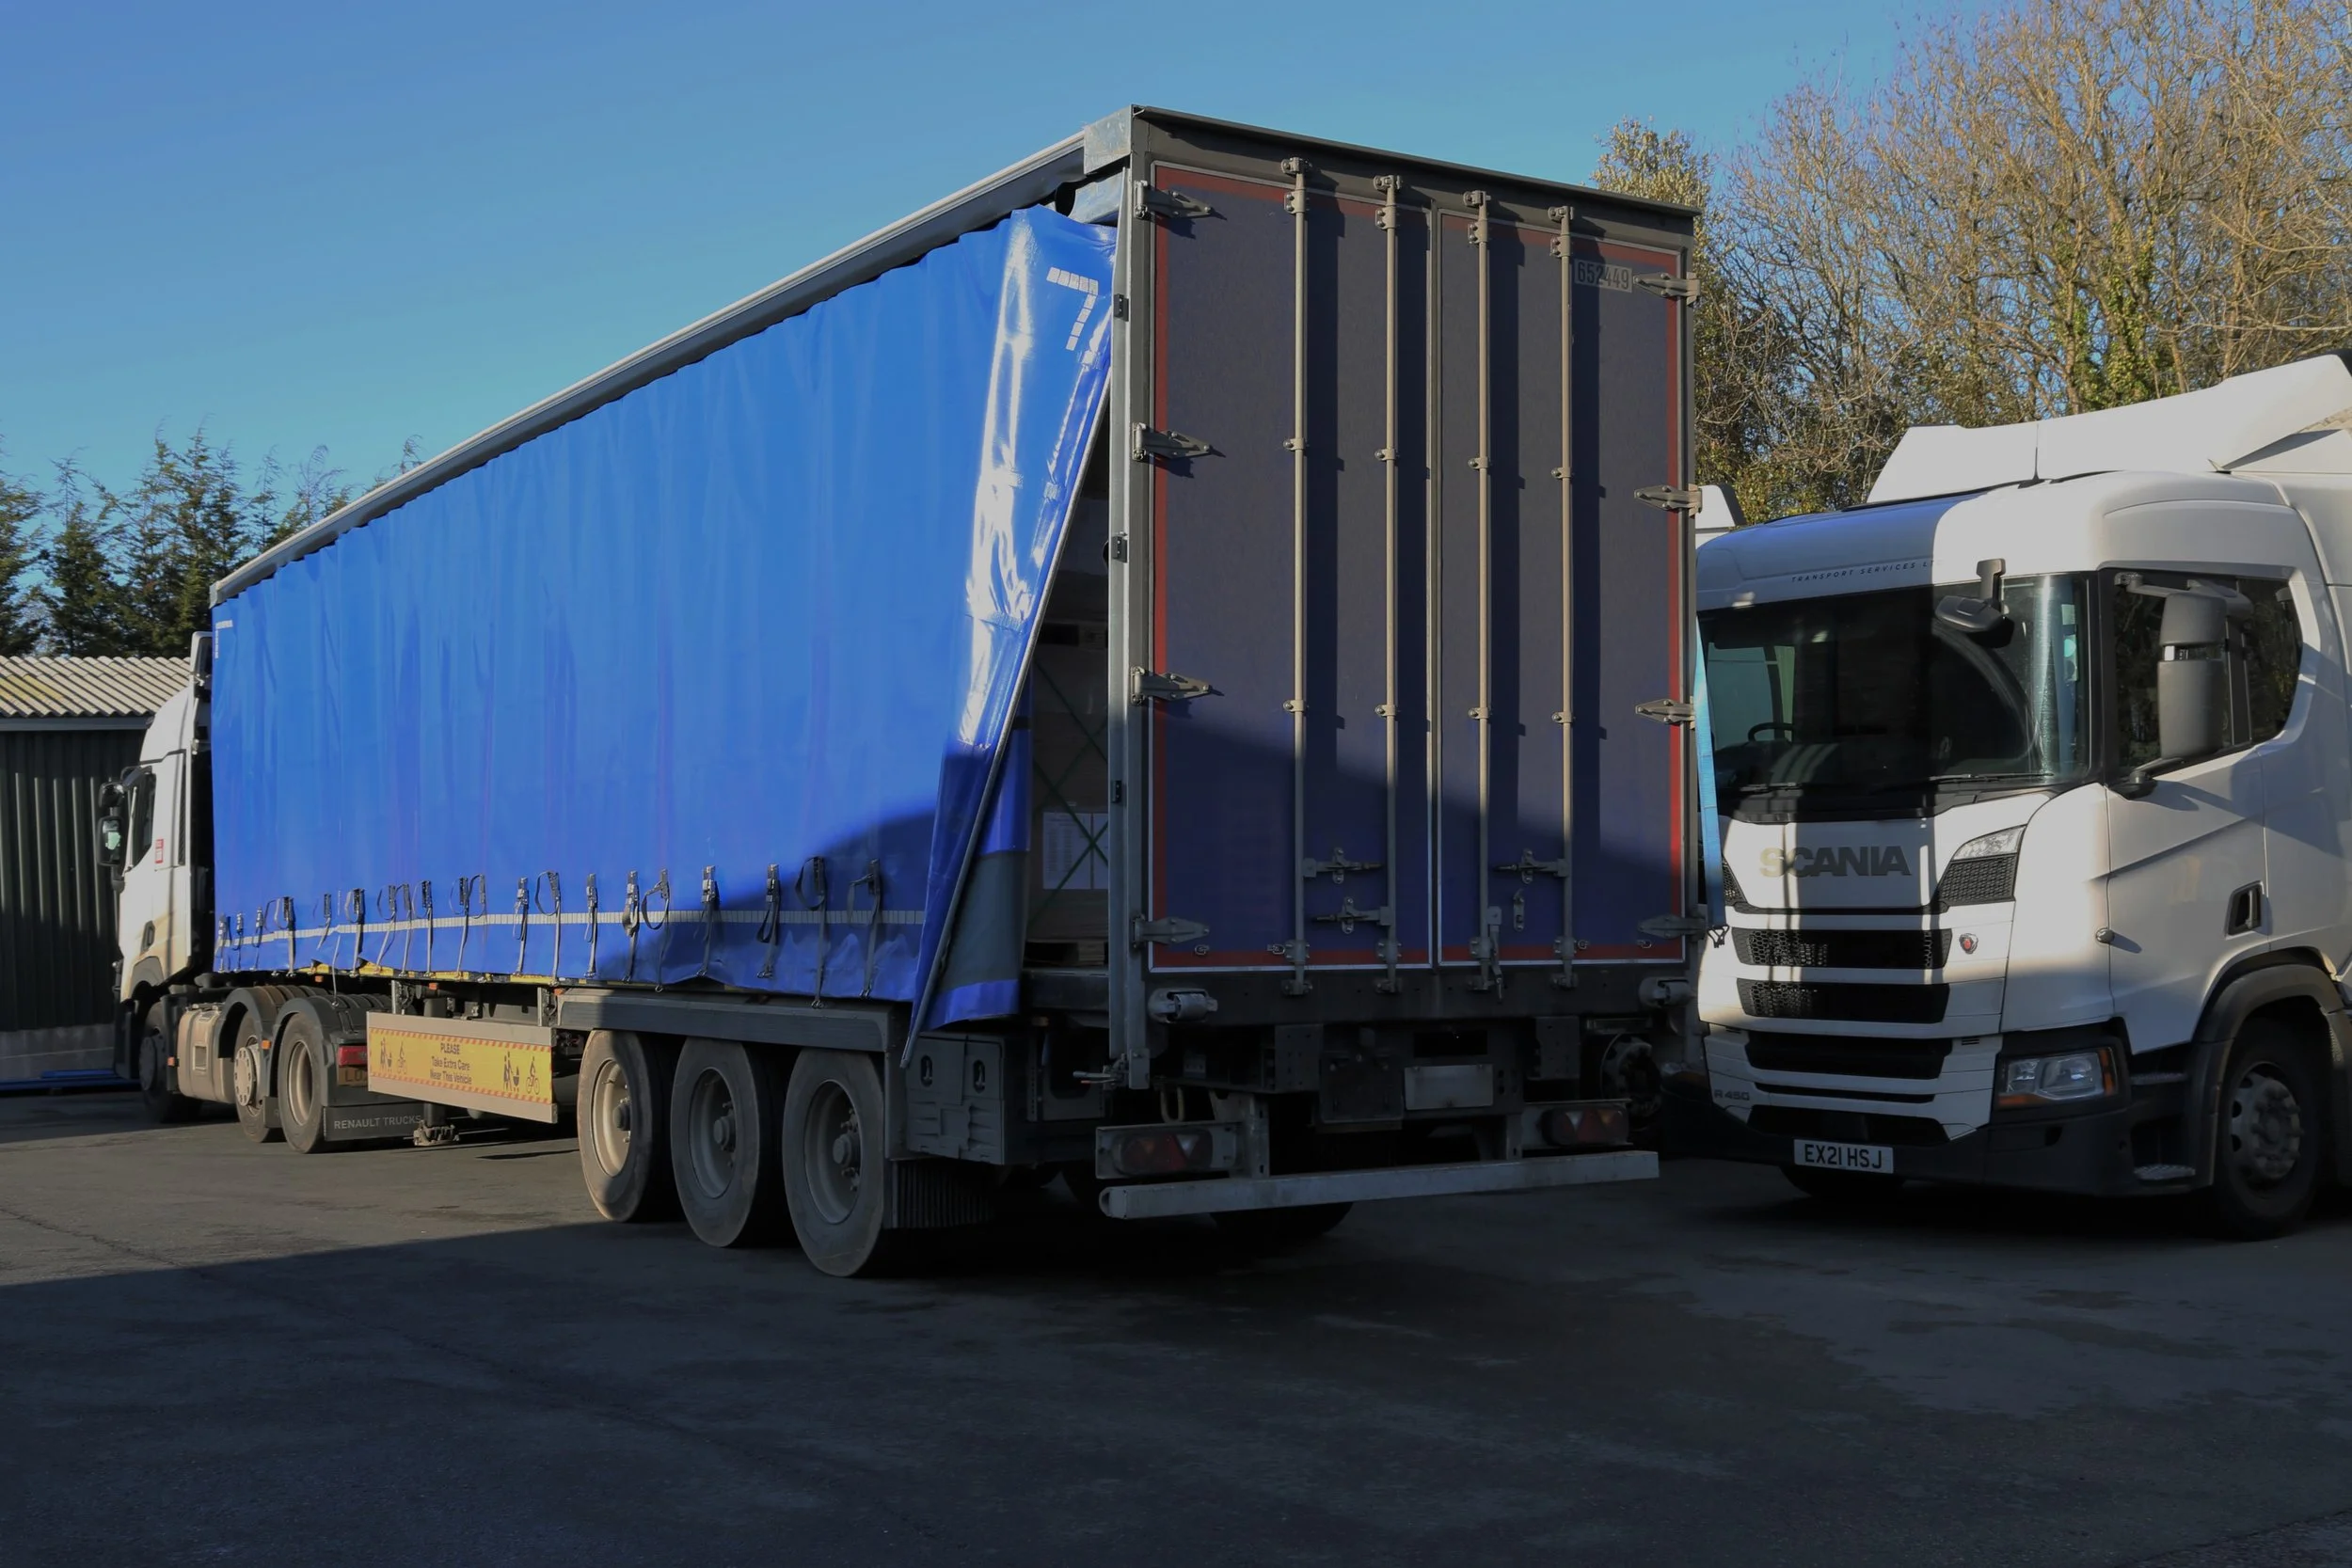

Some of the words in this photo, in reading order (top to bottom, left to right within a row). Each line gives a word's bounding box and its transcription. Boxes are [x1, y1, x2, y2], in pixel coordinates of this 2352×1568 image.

[1577, 261, 1629, 290] 652449
[1791, 569, 1854, 582] TRANSPORT
[1860, 562, 1915, 574] SERVICES
[1760, 846, 1913, 878] SCANIA
[440, 1042, 460, 1054] PLEASE
[432, 1055, 443, 1068] Take
[443, 1057, 457, 1069] Extra
[457, 1059, 470, 1071] Care
[430, 1069, 442, 1080] Near
[442, 1069, 453, 1082] This
[453, 1073, 472, 1085] Vehicle
[1714, 1089, 1723, 1099] R
[1724, 1090, 1750, 1101] 450
[334, 1117, 381, 1130] RENAULT
[382, 1115, 421, 1127] TRUCKS
[1804, 1143, 1842, 1165] EX21
[1847, 1147, 1883, 1169] HSJ
